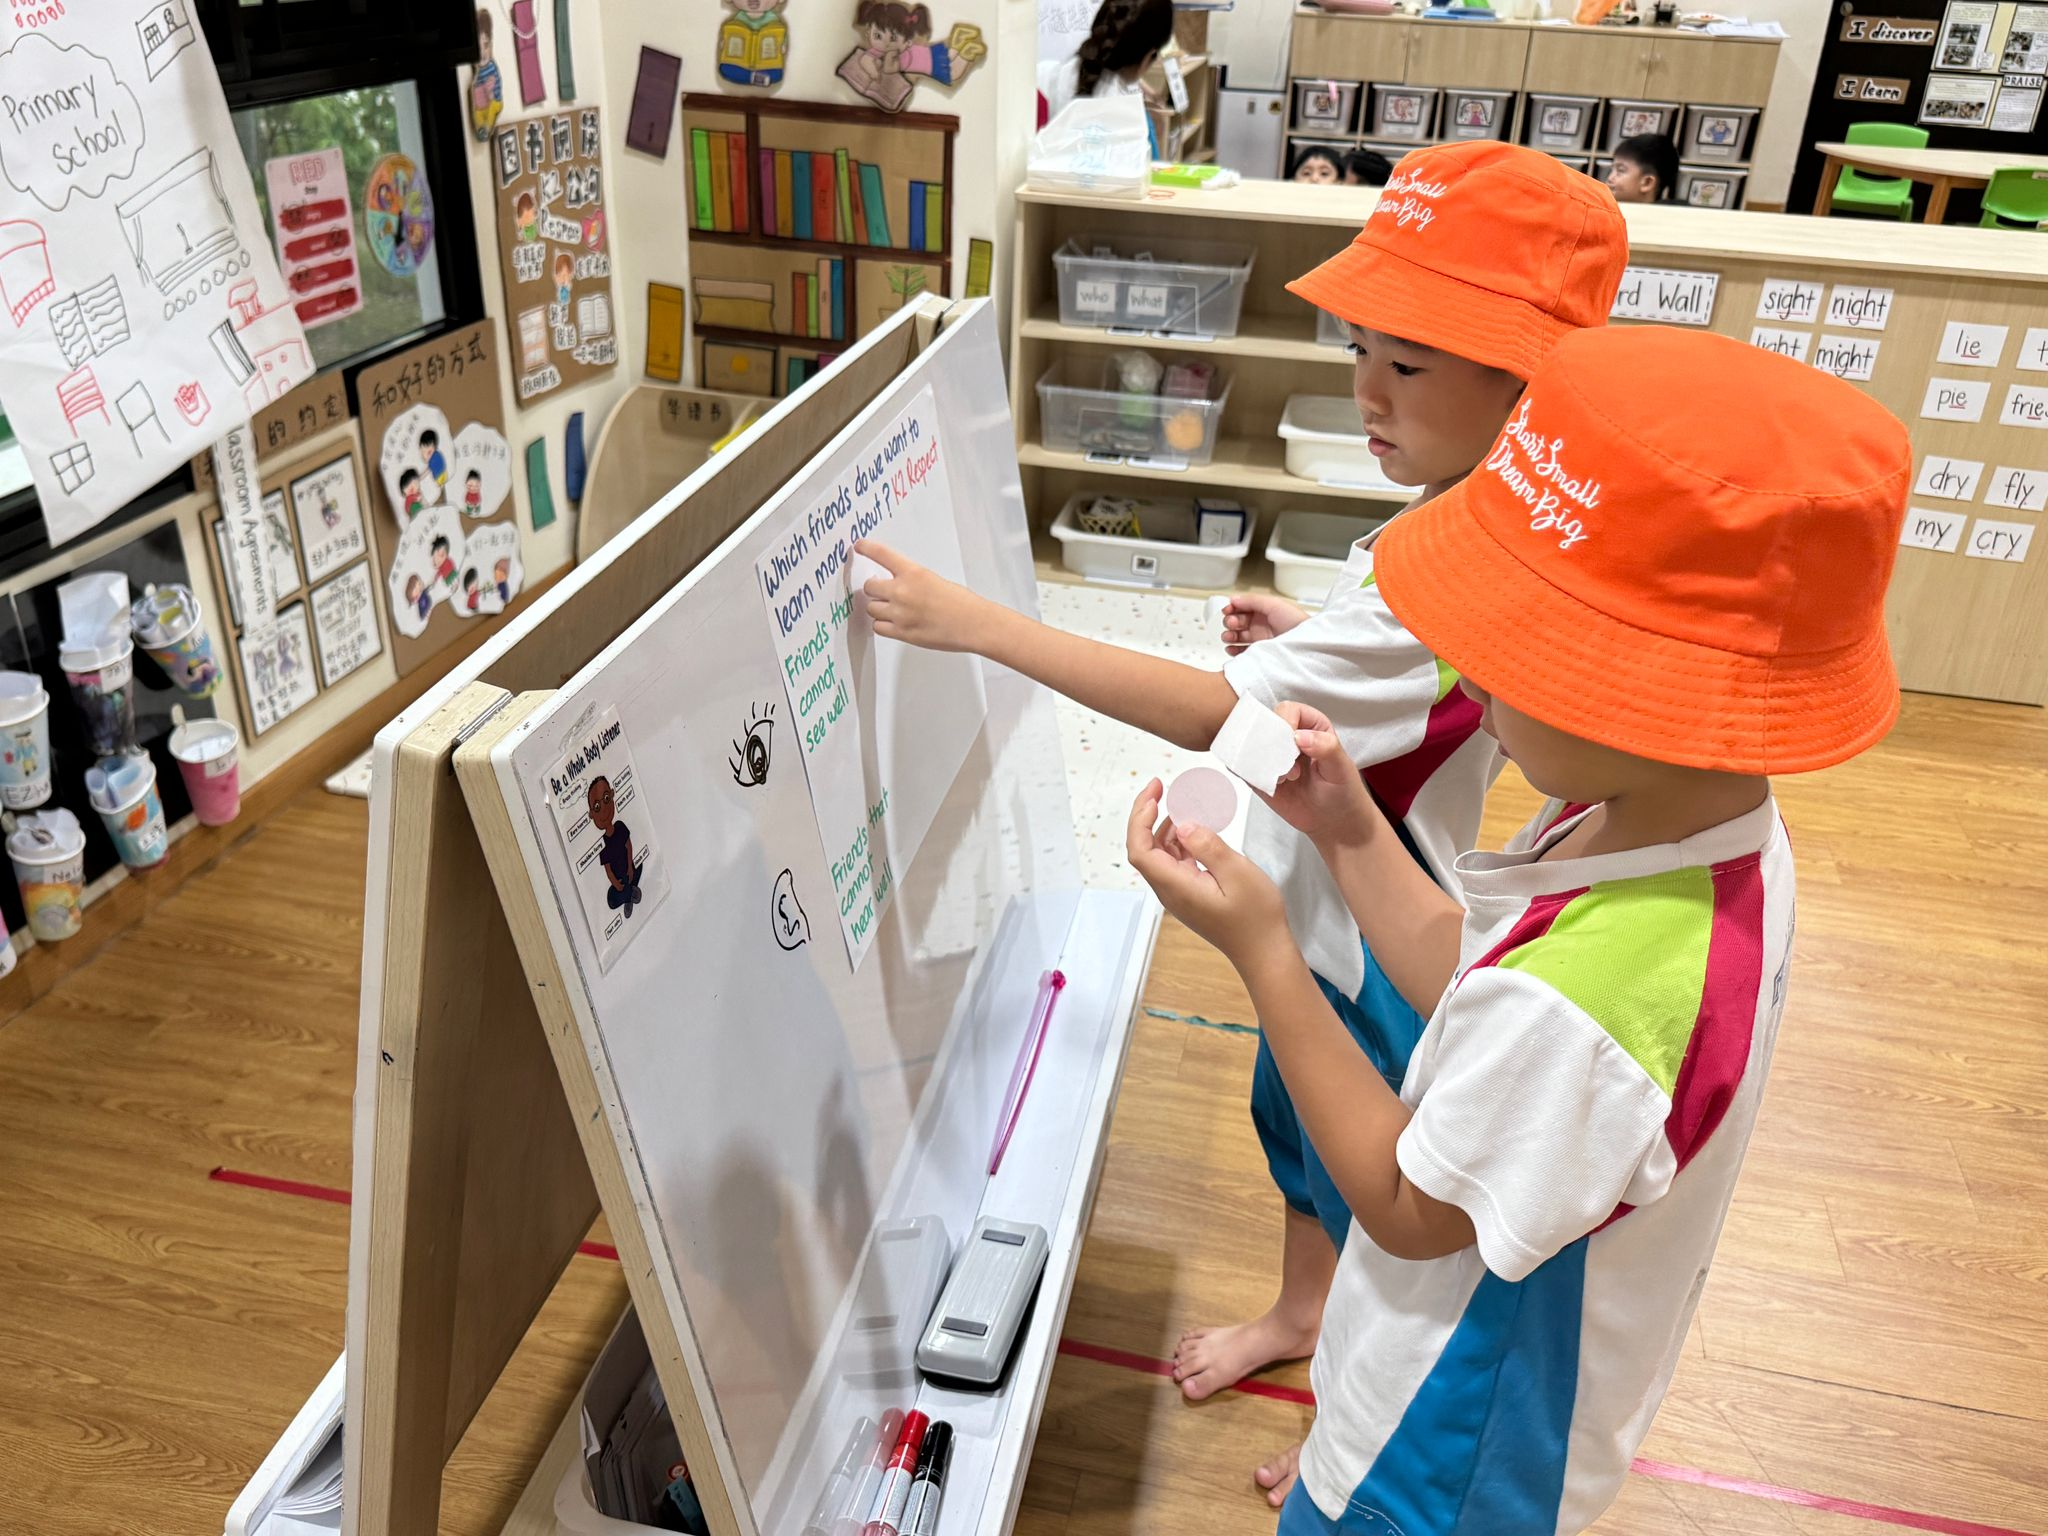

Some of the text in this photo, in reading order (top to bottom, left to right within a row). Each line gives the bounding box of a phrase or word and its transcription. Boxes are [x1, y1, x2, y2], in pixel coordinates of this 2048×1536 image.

[1849, 20, 1933, 41] I discover
[1841, 80, 1901, 99] I learn
[2004, 75, 2043, 88] PRAISE
[2, 74, 98, 134] Primary
[53, 109, 126, 175] School
[289, 158, 326, 185] RED
[1398, 168, 1448, 199] Small
[1397, 196, 1437, 232] Big
[1617, 279, 1703, 313] rd Wall
[1765, 283, 1816, 320] sight
[1832, 289, 1887, 326] night
[1815, 343, 1874, 378] might
[1956, 329, 1981, 356] lie
[1937, 387, 1967, 412] pie
[2012, 393, 2048, 417] frie
[1506, 397, 1601, 510] Start Small
[891, 469, 908, 506] K2
[1486, 435, 1589, 550] Dream Big
[1930, 461, 1970, 500] dry
[2005, 471, 2035, 509] fly
[227, 425, 269, 617] lassroom Agreements
[764, 416, 919, 599] Which friends do we want to
[1915, 518, 1952, 548] my
[1976, 530, 2023, 559] cry
[774, 583, 815, 638] learn
[814, 538, 849, 590] more
[850, 492, 882, 545] about
[784, 587, 854, 688] Friends that
[800, 654, 835, 717] cannot
[806, 678, 849, 753] see well
[550, 777, 562, 797] Be
[565, 752, 586, 782] Whole
[583, 739, 601, 765] Body
[598, 720, 621, 751] Listener
[831, 786, 889, 893] Friends that
[840, 851, 875, 917] cannot
[851, 856, 893, 945] hear well
